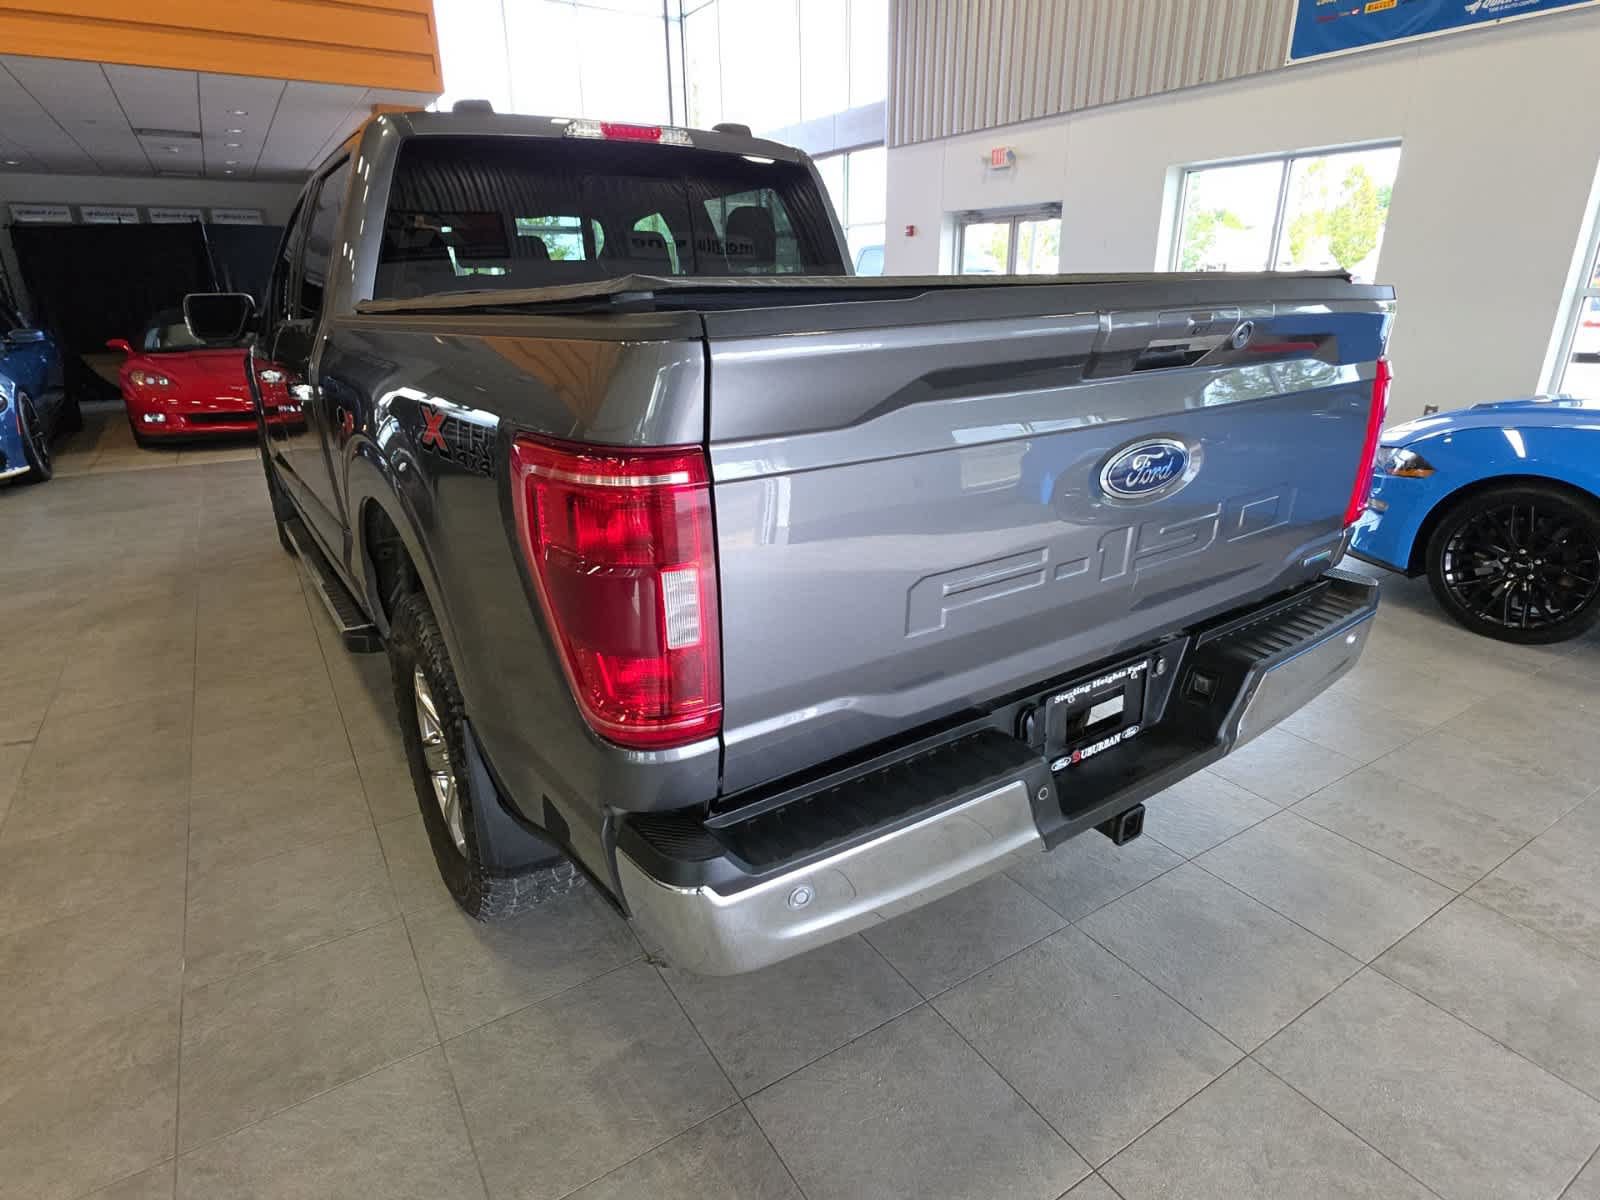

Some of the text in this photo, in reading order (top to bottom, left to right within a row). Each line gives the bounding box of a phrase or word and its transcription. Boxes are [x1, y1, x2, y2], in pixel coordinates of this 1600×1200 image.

[1125, 450, 1175, 488] Ford
[904, 488, 1296, 639] F-150
[1054, 660, 1148, 704] Sterling Heights Ford
[1072, 733, 1121, 763] SUBURBAN
